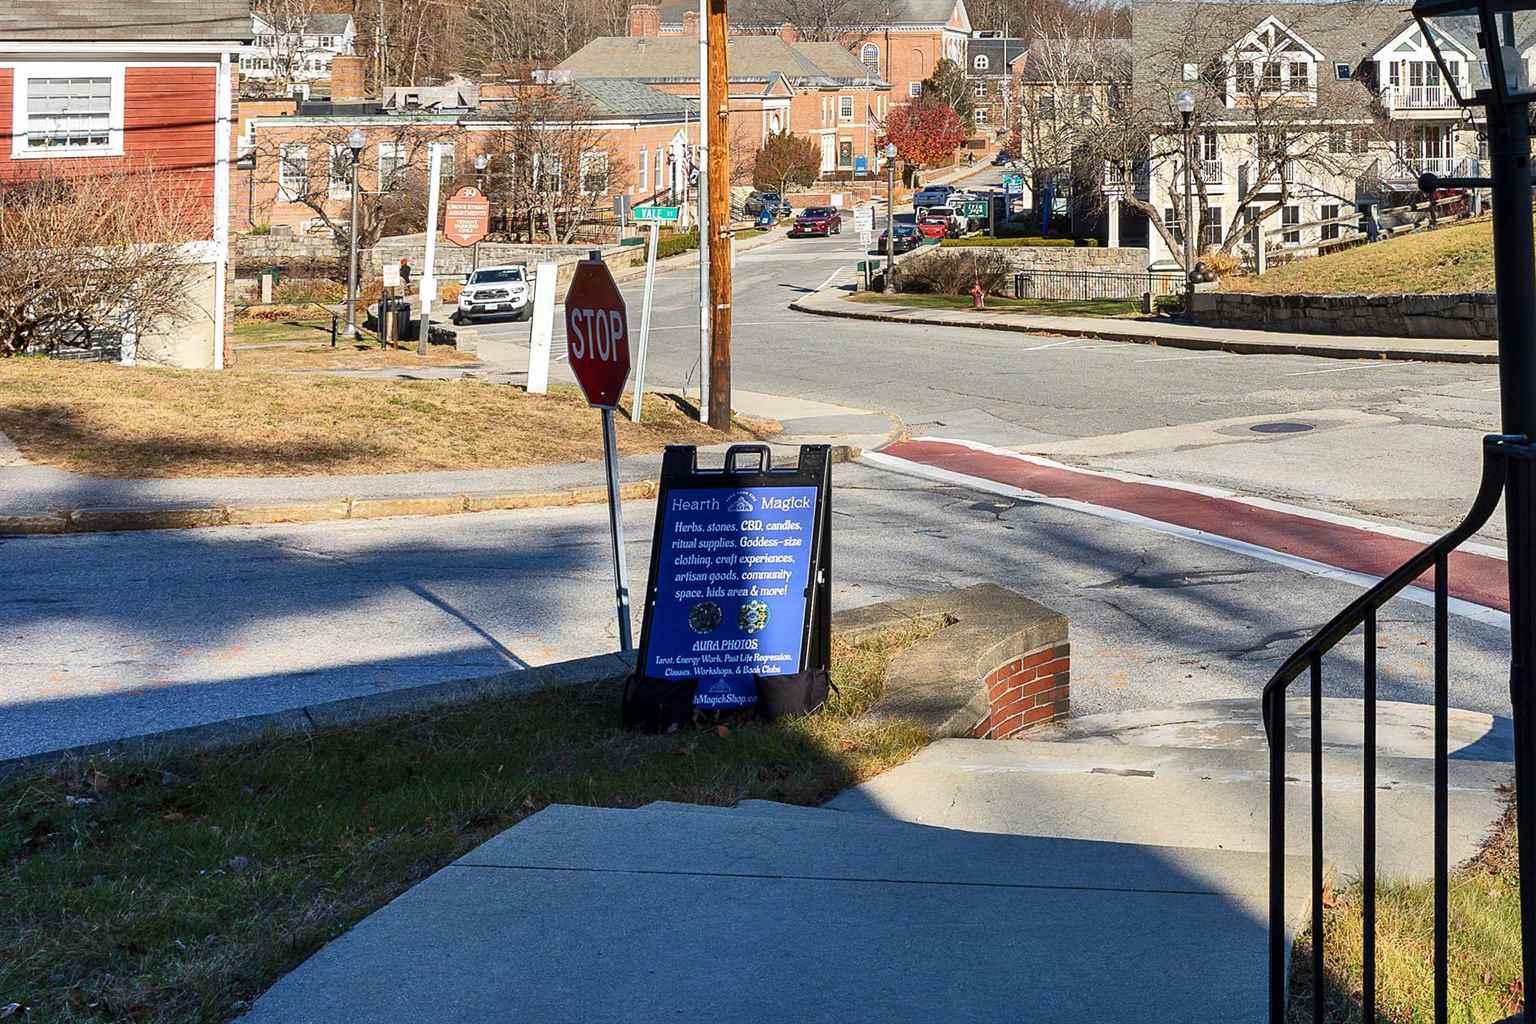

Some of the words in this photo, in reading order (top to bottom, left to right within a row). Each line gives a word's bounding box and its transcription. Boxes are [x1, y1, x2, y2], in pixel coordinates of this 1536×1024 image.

[641, 208, 662, 218] YALE
[571, 307, 624, 362] STOP
[672, 497, 720, 511] Hearth
[761, 496, 811, 511] Magick
[672, 538, 697, 549] ritual
[716, 553, 737, 566] craft
[674, 570, 707, 582] artisan
[741, 569, 792, 583] community
[706, 586, 726, 598] kids
[727, 588, 748, 597] area
[750, 585, 758, 596] &
[760, 585, 788, 596] more!
[692, 639, 720, 651] AURA
[721, 638, 759, 651] PHOTOS
[676, 655, 701, 666] Energy
[743, 665, 761, 674] Book
